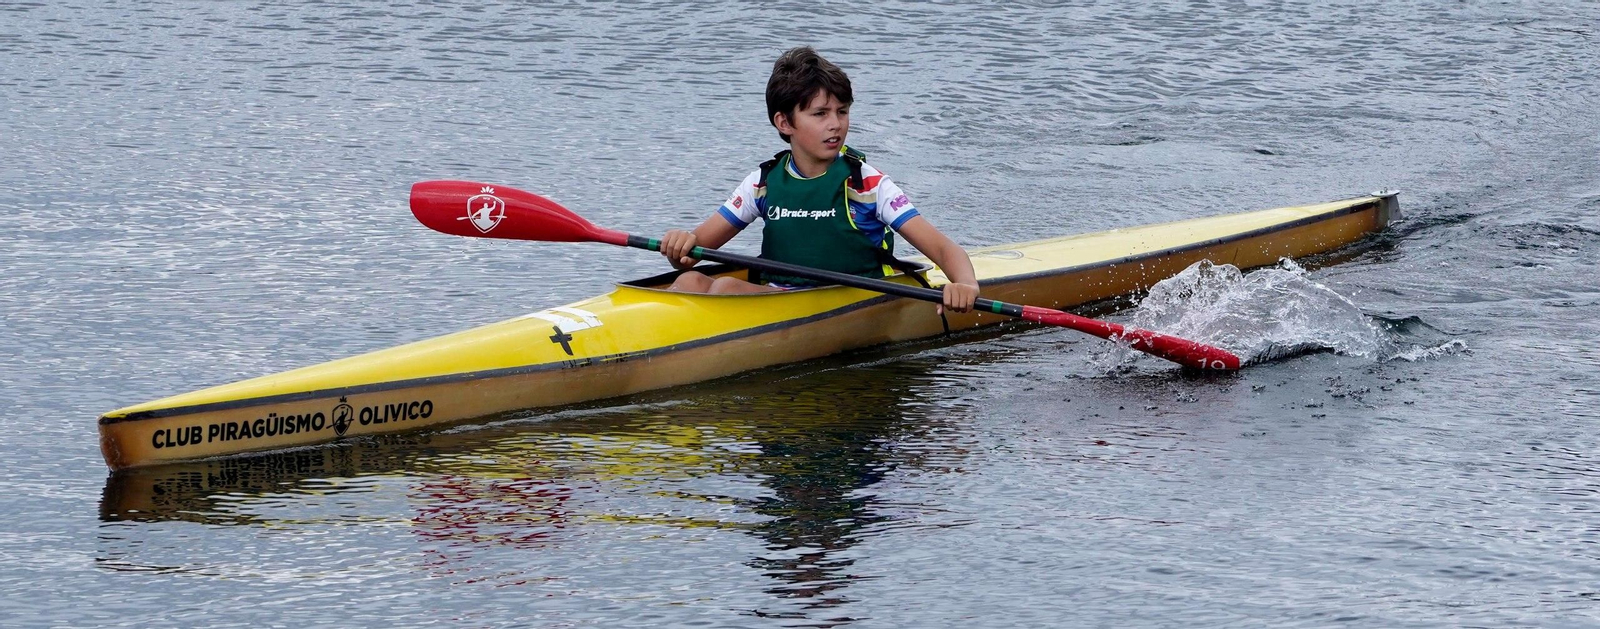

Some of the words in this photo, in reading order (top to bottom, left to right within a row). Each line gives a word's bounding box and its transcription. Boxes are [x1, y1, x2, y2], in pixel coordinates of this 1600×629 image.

[152, 425, 203, 449] CLUB
[207, 412, 326, 443] PIRAGÜISMO
[358, 400, 434, 426] OLIVICO
